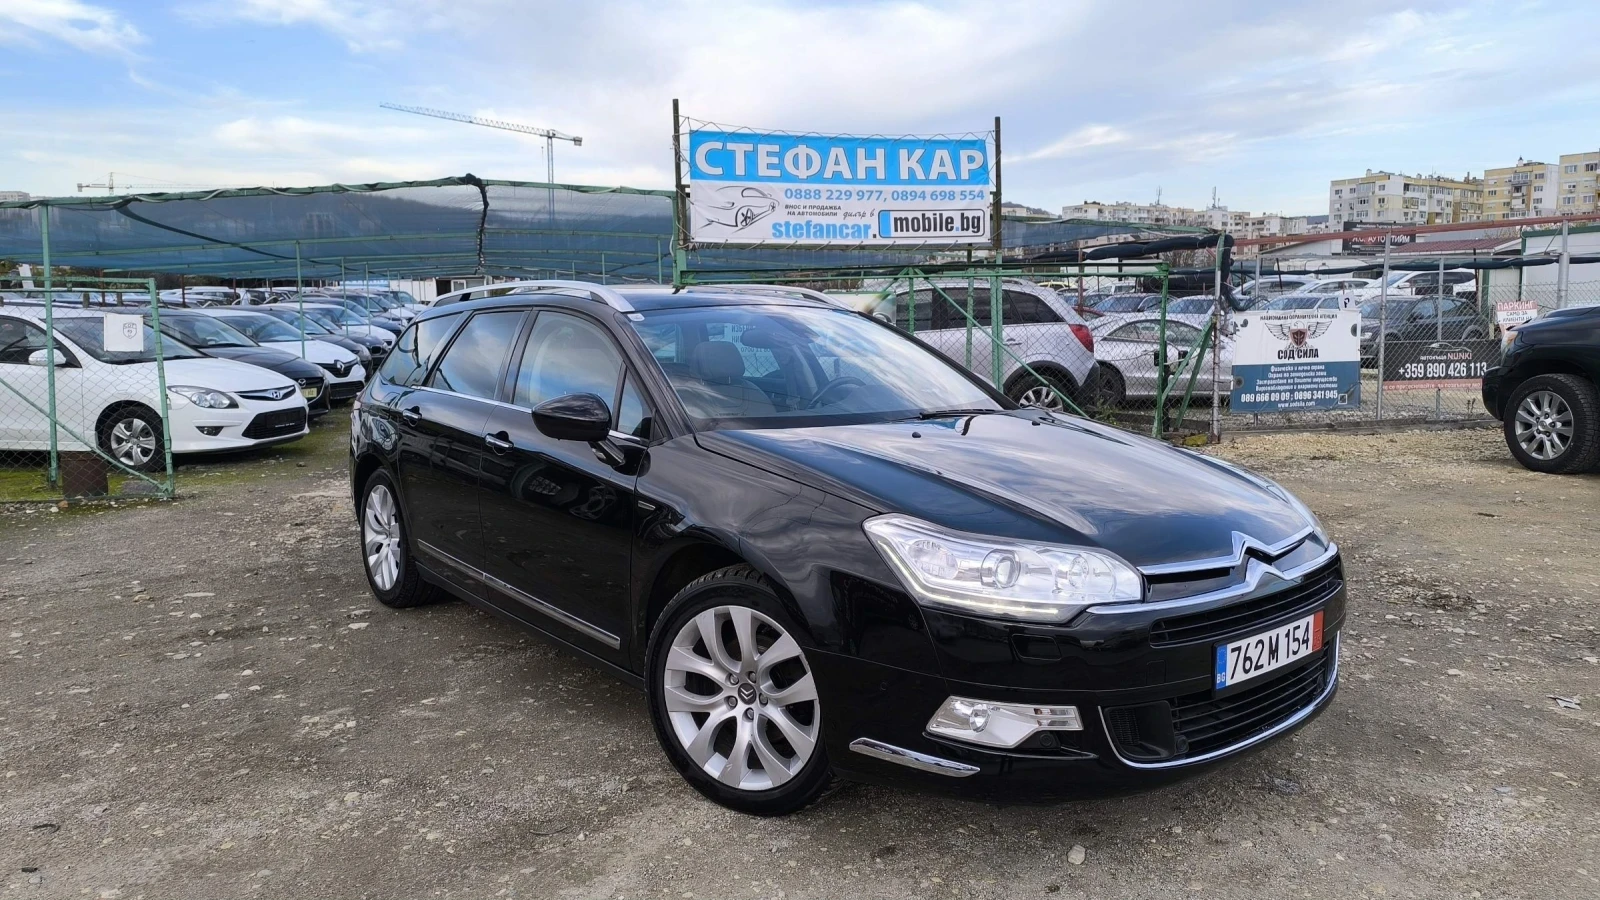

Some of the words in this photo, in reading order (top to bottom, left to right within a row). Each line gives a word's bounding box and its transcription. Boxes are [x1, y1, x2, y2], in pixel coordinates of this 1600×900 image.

[694, 141, 887, 180] СТЕФАН
[899, 148, 986, 181] КАР
[785, 188, 822, 200] 0888
[825, 189, 853, 201] 229
[856, 190, 887, 203] 977,
[891, 189, 926, 202] 0894
[930, 190, 957, 202] 698
[959, 189, 986, 201] 554
[893, 212, 982, 234] mobile.bg
[1391, 234, 1410, 243] ТИЙМ
[1497, 300, 1534, 311] ПАРКИНГ
[1277, 349, 1295, 361] СОД
[1296, 348, 1319, 359] СИЛА
[1447, 352, 1472, 360] NUNKI
[1398, 363, 1424, 378] +359
[1426, 362, 1446, 377] 890
[1447, 362, 1467, 377] 426
[1469, 361, 1487, 376] 113
[1240, 393, 1255, 403] 089
[1255, 392, 1270, 402] 666
[1270, 392, 1280, 401] 09
[1280, 391, 1290, 401] 09
[1294, 390, 1312, 400] 0896
[1312, 390, 1324, 399] 341
[1325, 389, 1338, 399] 945
[1216, 671, 1226, 684] BG
